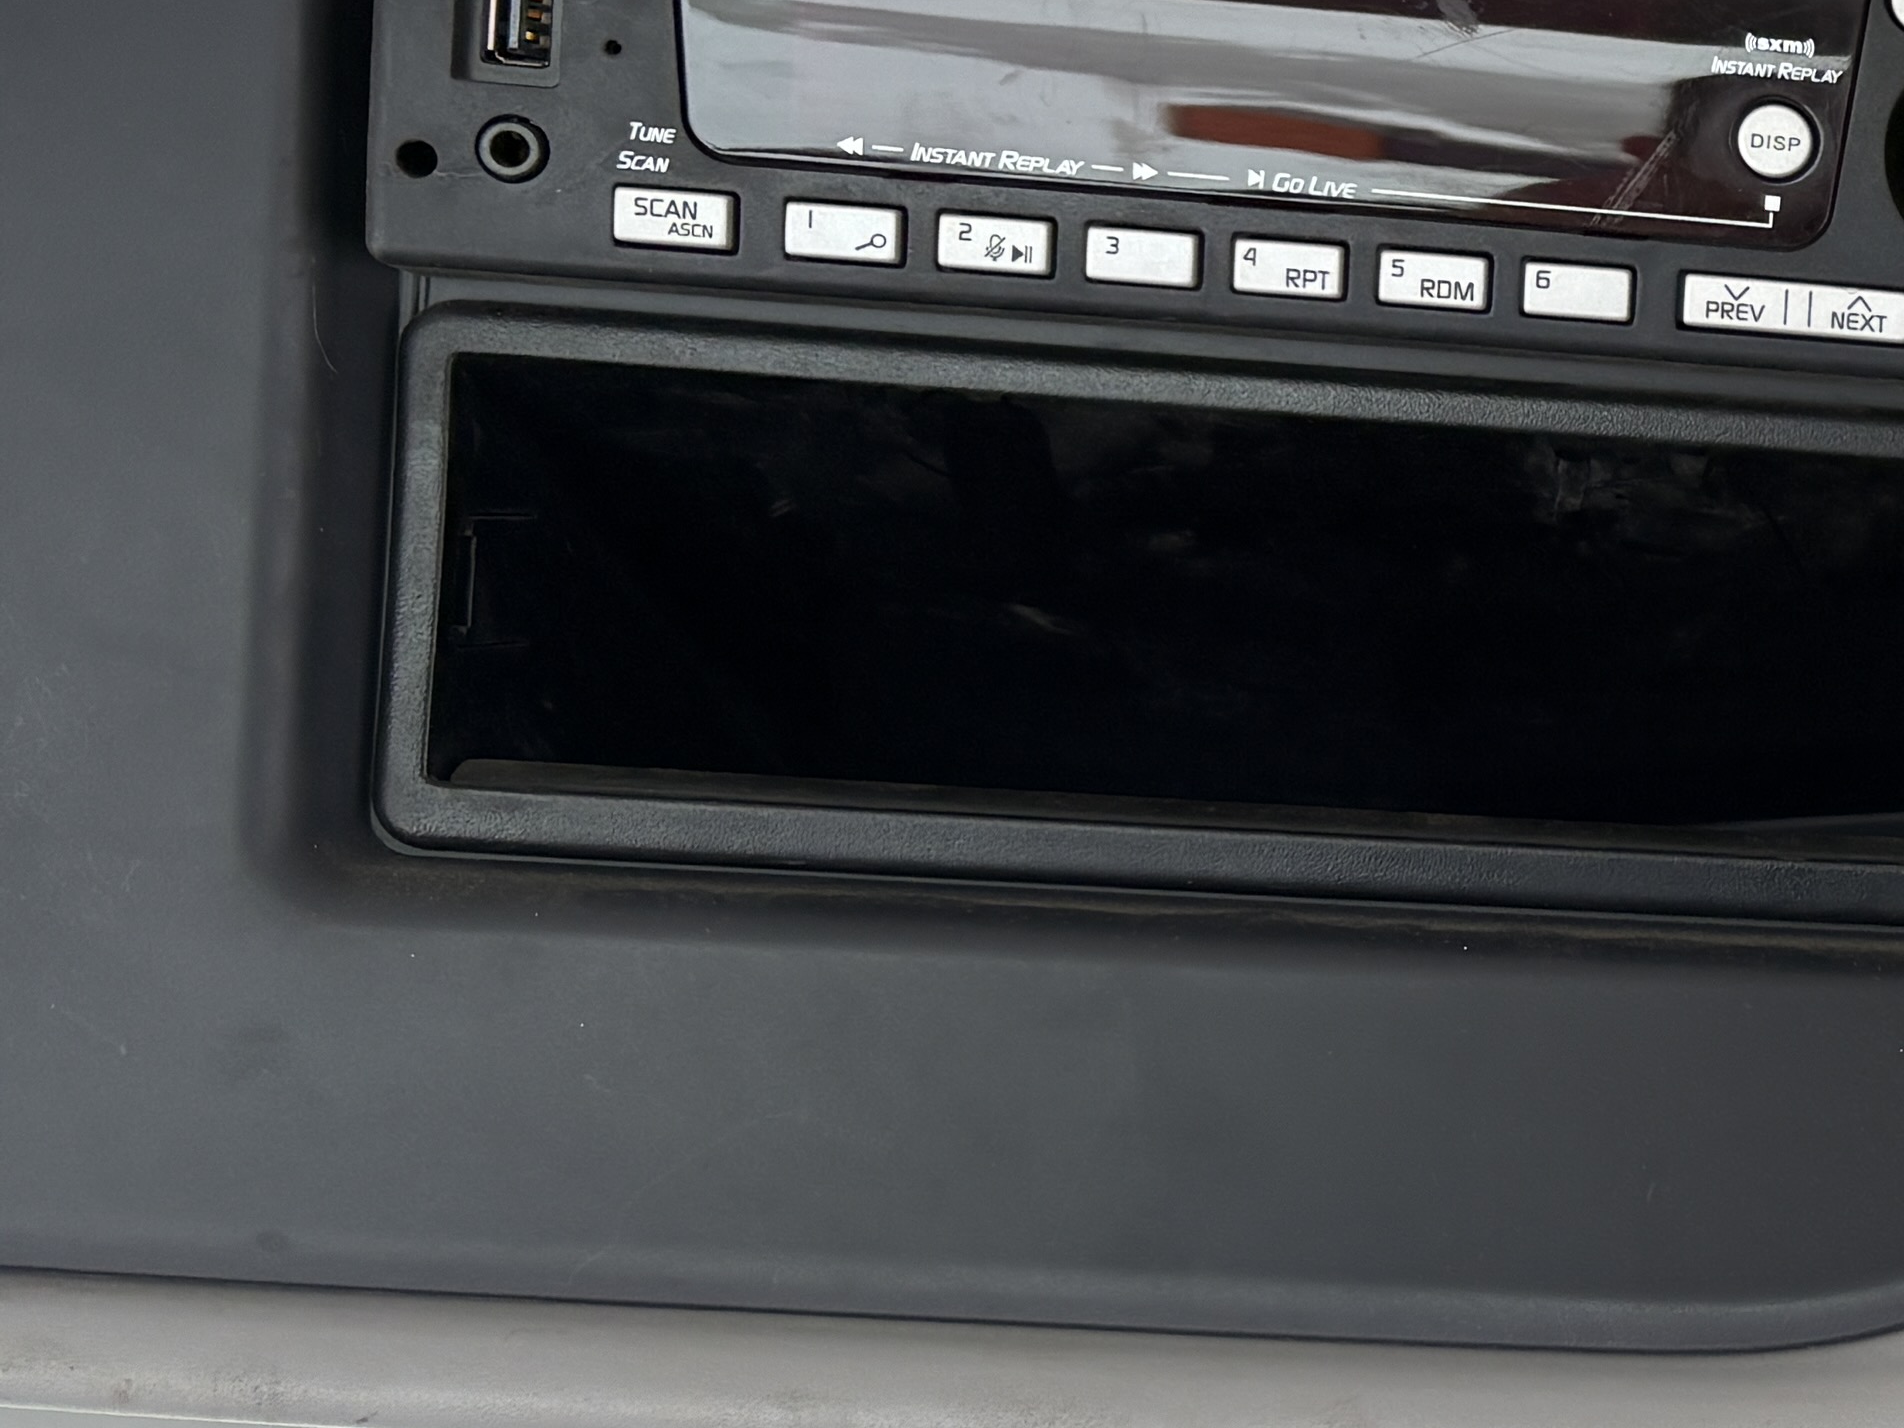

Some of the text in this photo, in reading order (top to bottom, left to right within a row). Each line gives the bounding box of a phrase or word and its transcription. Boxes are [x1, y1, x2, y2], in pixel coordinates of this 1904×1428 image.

[1750, 133, 1801, 152] DISP
[634, 197, 698, 220] SCAN
[667, 222, 713, 239] ASCN
[958, 222, 973, 241] 2
[1105, 236, 1119, 255] 3
[1243, 247, 1257, 267] 4
[1391, 259, 1405, 278] 5
[1285, 268, 1330, 290] RPT
[1535, 270, 1551, 290] 6
[1420, 279, 1475, 302] RDM
[1705, 300, 1766, 323] PREV
[1831, 310, 1888, 333] NEXT
